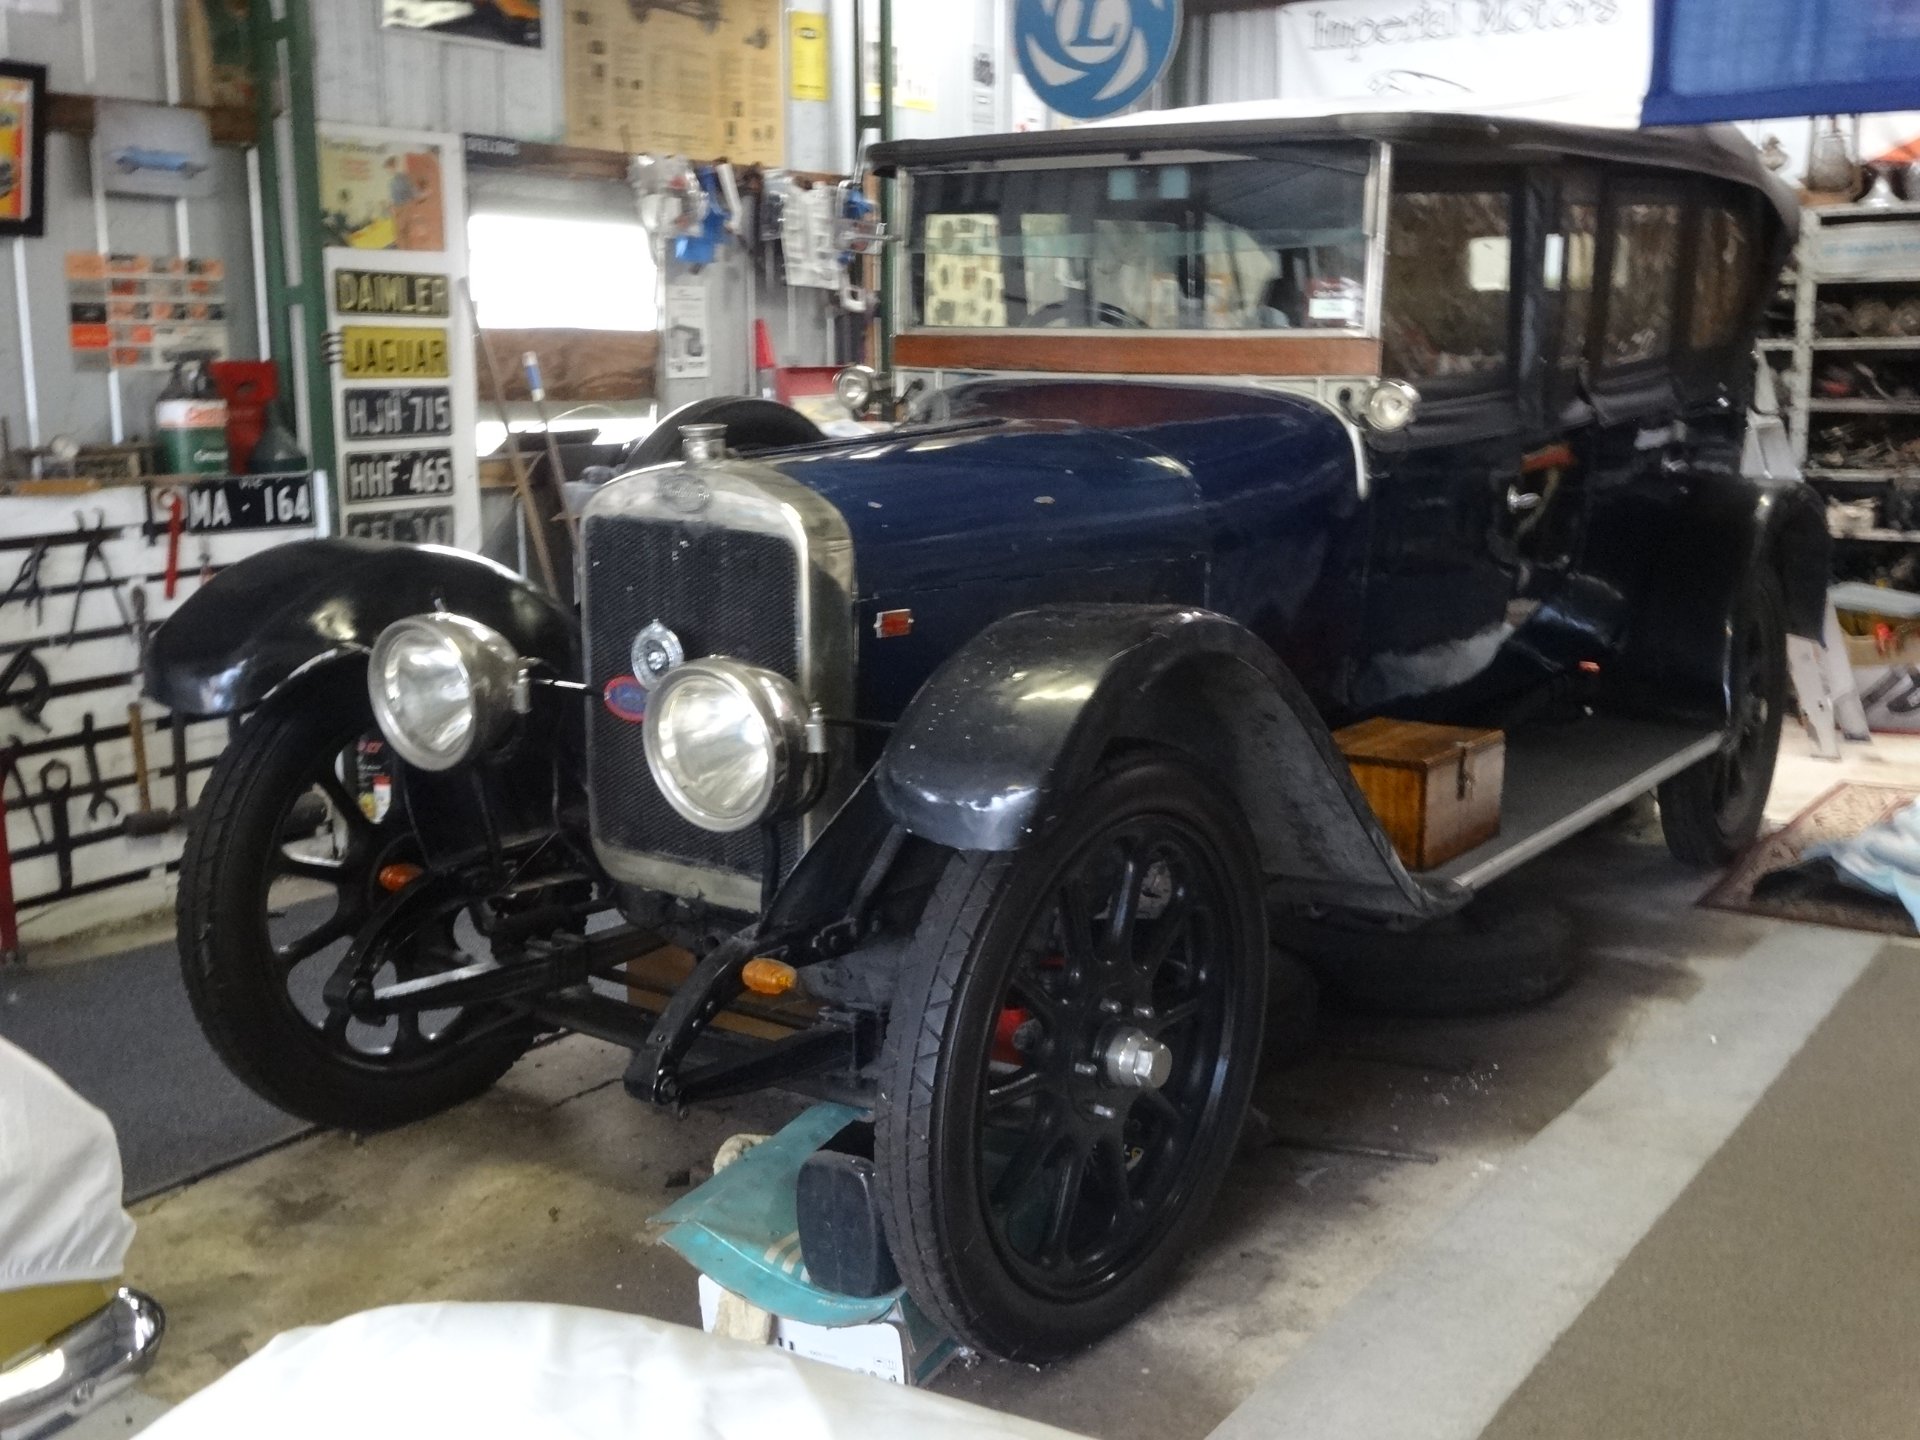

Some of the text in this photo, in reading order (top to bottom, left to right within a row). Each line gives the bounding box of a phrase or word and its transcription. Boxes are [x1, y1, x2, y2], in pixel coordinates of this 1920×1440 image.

[1307, 0, 1453, 62] Imperial
[337, 272, 449, 313] DAIMLER
[347, 338, 447, 374] JAGUAR
